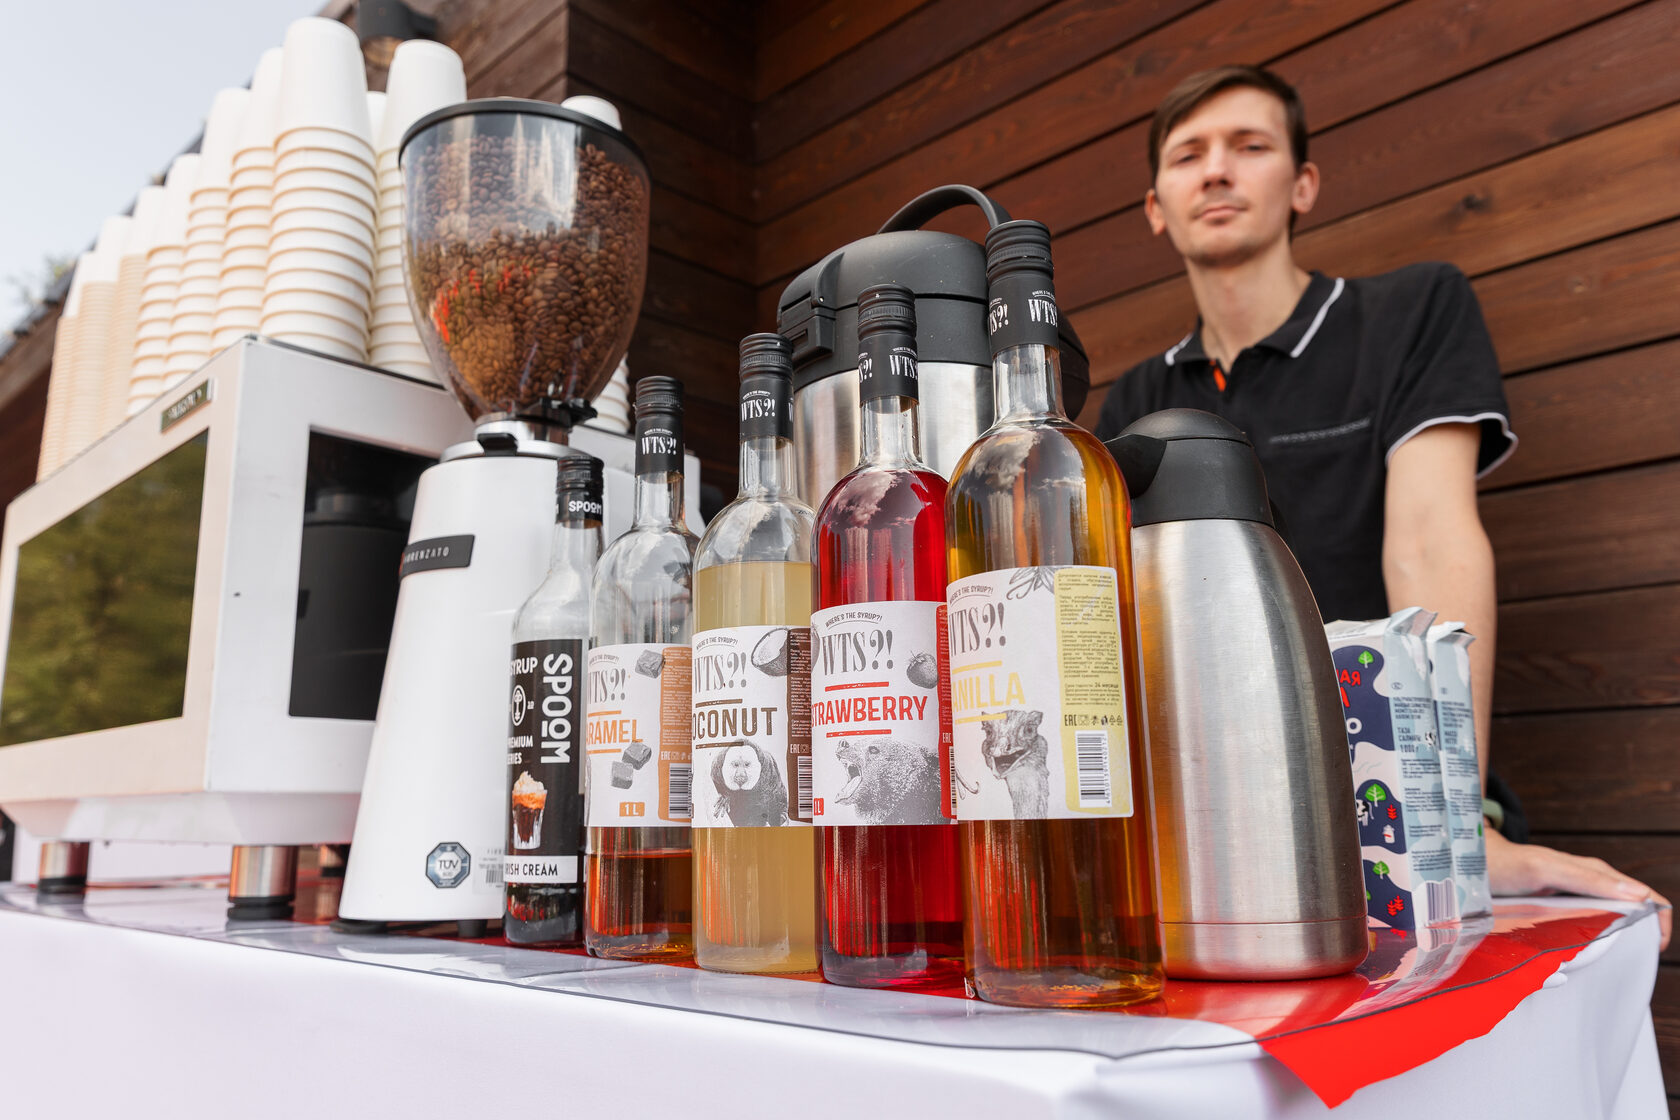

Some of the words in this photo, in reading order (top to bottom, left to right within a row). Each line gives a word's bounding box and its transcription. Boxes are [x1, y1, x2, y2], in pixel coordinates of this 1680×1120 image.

[641, 436, 677, 456] WTS?!
[857, 612, 883, 622] SYRUP?!
[822, 629, 894, 676] WTS?!
[1336, 669, 1361, 686] АЯ
[522, 862, 558, 876] CREAM
